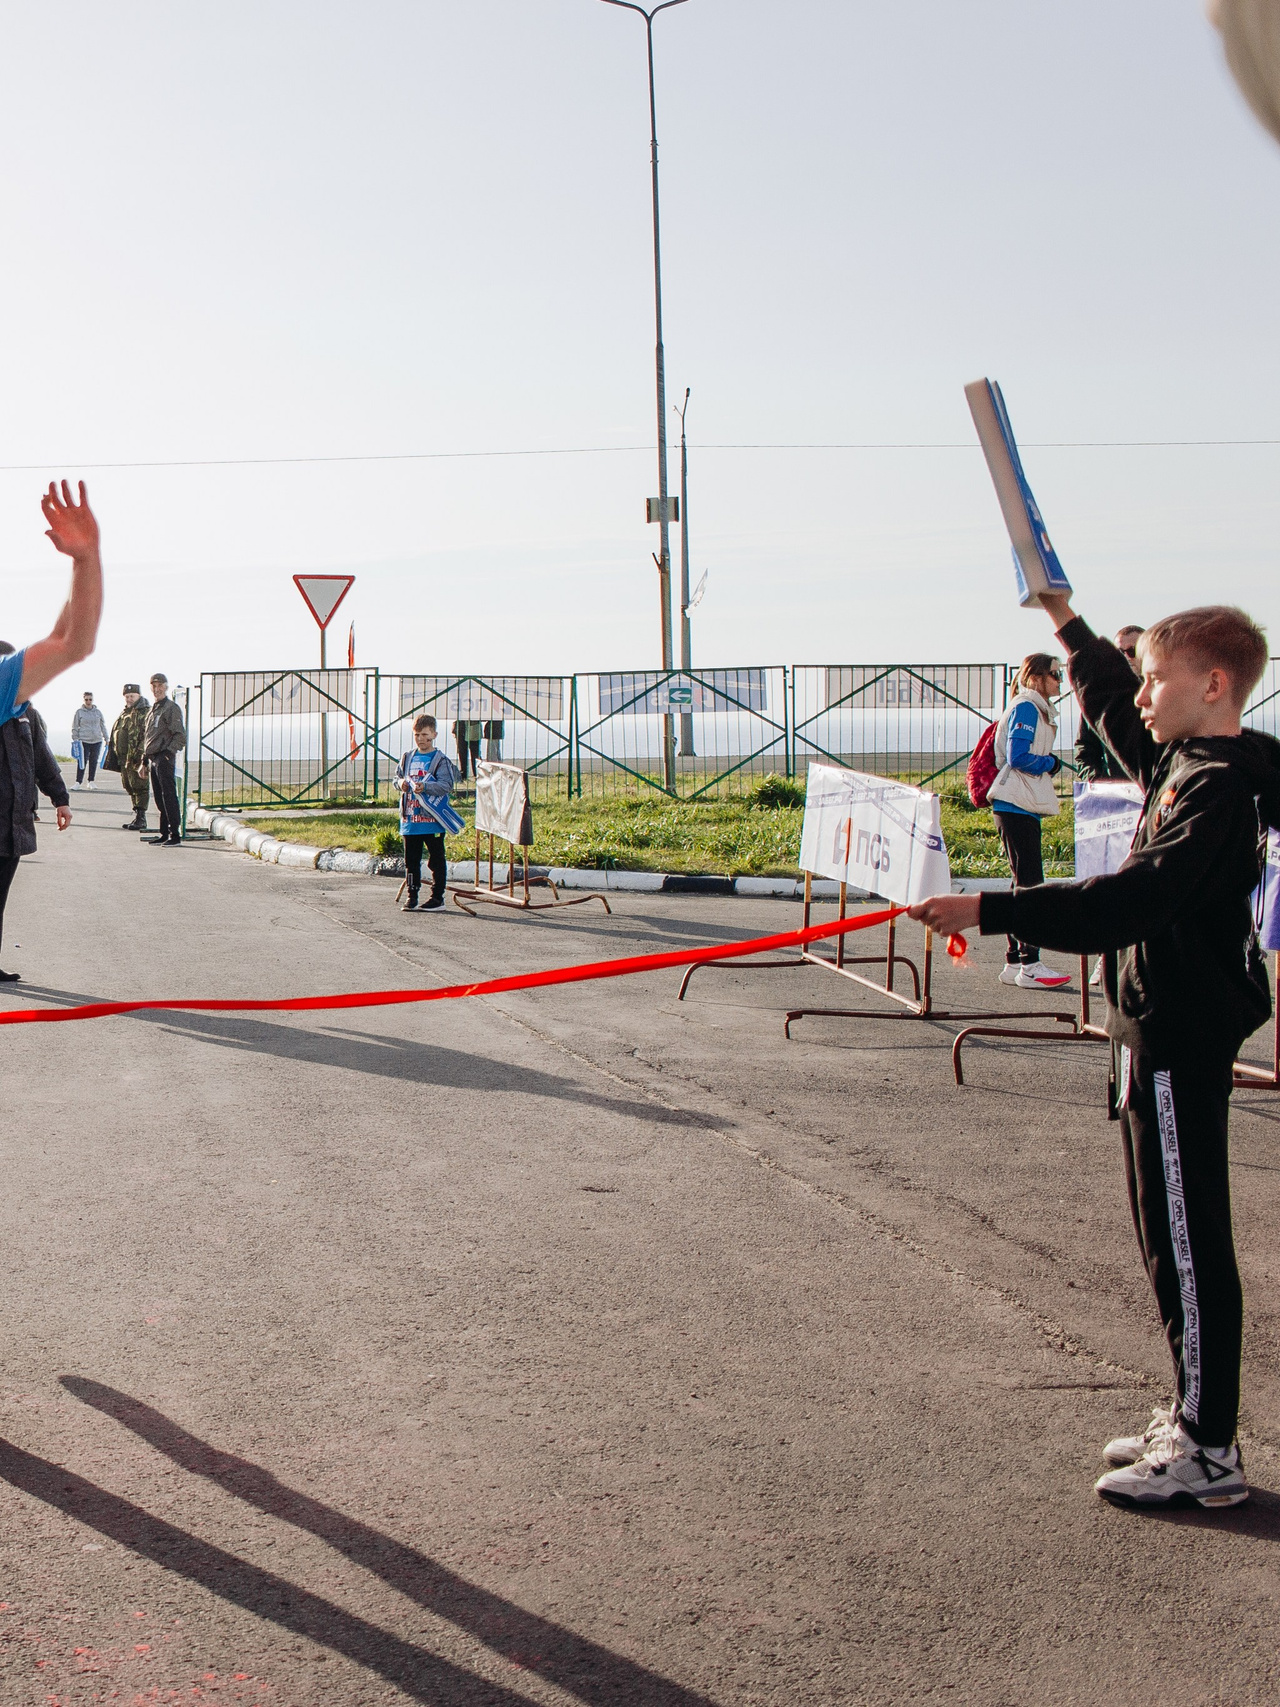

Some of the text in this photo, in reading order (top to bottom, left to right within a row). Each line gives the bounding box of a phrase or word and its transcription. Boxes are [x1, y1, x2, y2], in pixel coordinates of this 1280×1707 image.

[1023, 724, 1035, 733] ПС
[1096, 816, 1134, 832] ЗАБЕГ.РФ
[856, 829, 890, 873] ПСБ
[1162, 1090, 1172, 1112] OPEN
[1166, 1113, 1178, 1154] YOURSELF
[1175, 1199, 1190, 1263] OPEN YOURSELF
[1188, 1307, 1197, 1329] OPEN
[1189, 1331, 1199, 1369] YOURSELF
